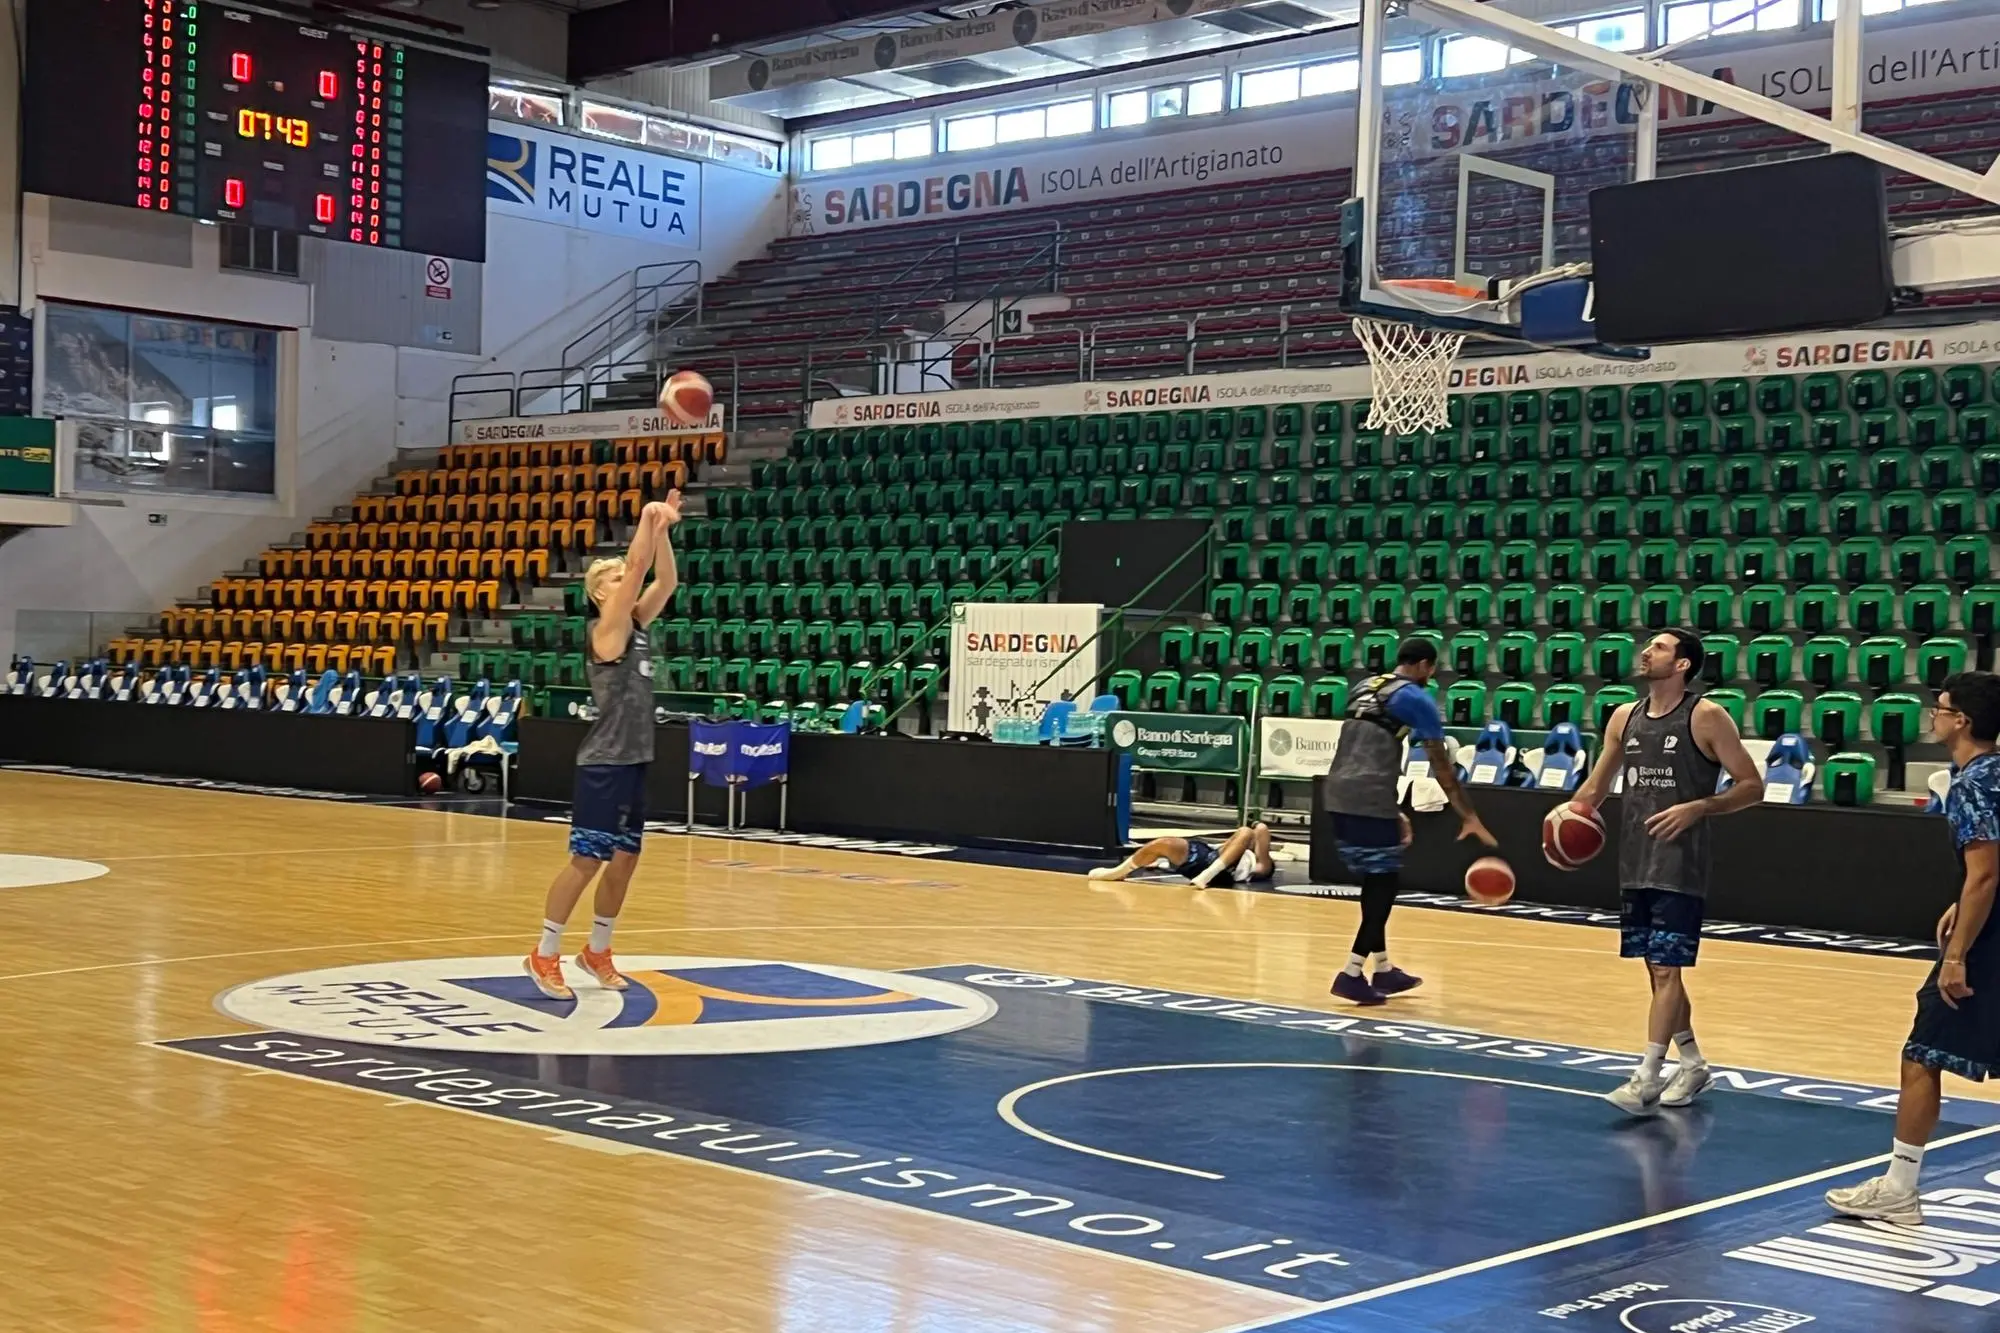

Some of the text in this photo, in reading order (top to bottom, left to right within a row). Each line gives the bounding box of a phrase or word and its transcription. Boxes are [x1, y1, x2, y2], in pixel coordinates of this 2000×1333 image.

[188, 6, 197, 19] 0
[144, 14, 197, 36] 5 0 0
[143, 33, 153, 46] 6
[188, 42, 196, 54] 0
[162, 54, 171, 67] 0
[373, 46, 382, 59] 0
[232, 52, 250, 82] 0
[357, 59, 365, 73] 5
[373, 63, 381, 76] 0
[161, 72, 171, 85] 0
[319, 70, 337, 99] 0
[356, 77, 365, 89] 6
[372, 80, 381, 93] 0
[1761, 65, 1832, 98] ISOL
[142, 86, 153, 100] 9
[161, 90, 170, 103] 0
[372, 97, 381, 109] 0
[161, 107, 170, 121] 0
[372, 114, 380, 127] 0
[138, 122, 152, 135] 11
[161, 125, 169, 139] 0
[355, 126, 380, 143] 9 0
[138, 139, 169, 157] 12 0
[371, 147, 380, 160] 0
[138, 157, 169, 174] 13 0
[352, 160, 363, 174] 11
[371, 164, 380, 177] 0
[138, 176, 168, 192] 14 0
[550, 145, 685, 206] REALE
[225, 178, 244, 208] 0
[351, 177, 379, 194] 12 0
[825, 144, 1283, 225] SARDEGNA ISOLA dell'Artigianato
[137, 193, 168, 210] 15 0
[316, 193, 334, 224] 0
[351, 194, 379, 210] 13 0
[549, 187, 685, 235] MUTUA
[370, 214, 379, 227] 0
[350, 228, 379, 244] 15 0
[1776, 339, 1934, 368] SARDEGNA
[1943, 341, 1989, 357] ISOLA
[1535, 367, 1572, 380] ISOLA
[1107, 385, 1211, 408] SARDEGNA
[1216, 386, 1248, 399] ISOLA
[854, 401, 941, 421] SARDEGNA
[477, 424, 545, 441] SARDEGNA
[967, 633, 1080, 653] SARDEGNA
[1137, 727, 1233, 749] Banco di Sardegna
[1296, 737, 1331, 750] Banco
[322, 981, 544, 1037] REALE
[1067, 987, 1290, 1020] BLUE
[253, 985, 439, 1041] MUTUA
[219, 1038, 1350, 1279] sardegnaturismo.it
[1537, 1281, 1670, 1319] Yacht Fuel
